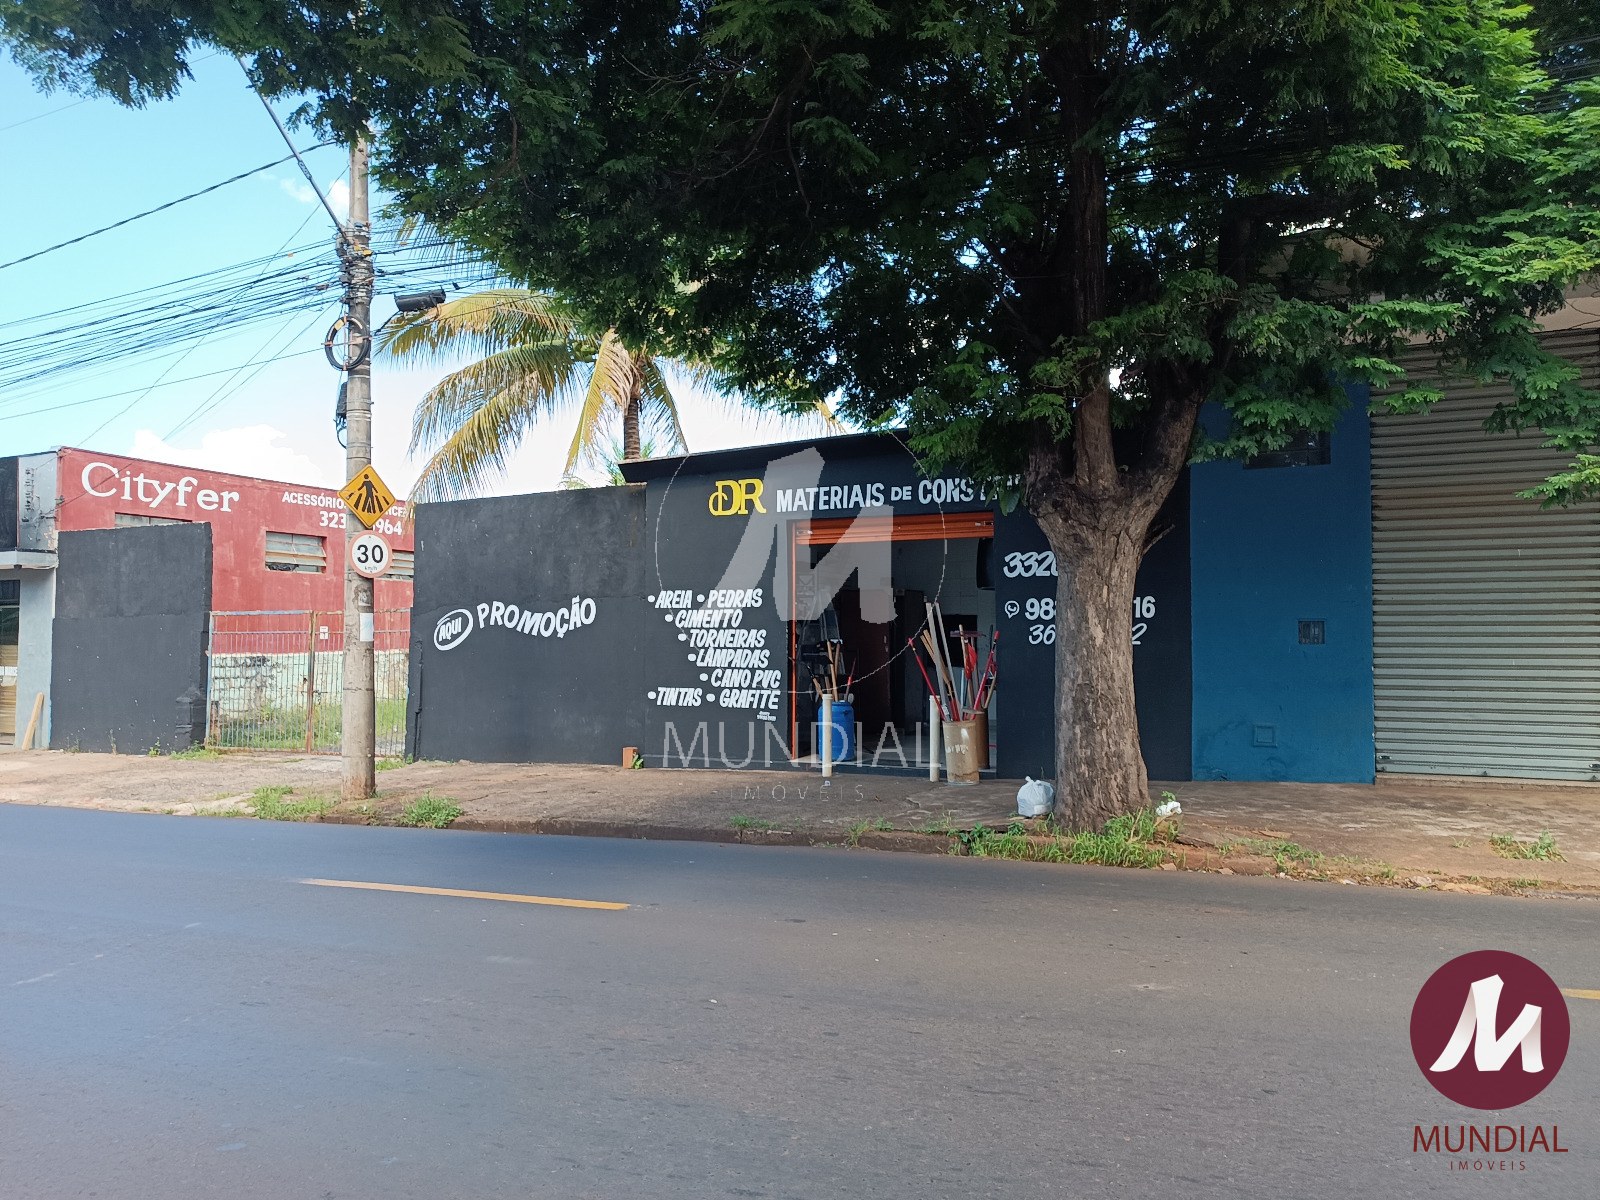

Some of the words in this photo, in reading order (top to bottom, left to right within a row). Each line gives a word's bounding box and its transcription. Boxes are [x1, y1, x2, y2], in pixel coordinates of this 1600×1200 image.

[81, 462, 240, 512] Cityfer
[282, 491, 346, 509] ACESSÓRIO
[776, 482, 885, 513] MATERIAIS
[891, 485, 913, 501] DE
[356, 544, 384, 564] 30
[655, 590, 692, 608] AREIA
[707, 588, 763, 608] PEDRAS
[438, 616, 462, 642] AQUI
[476, 595, 597, 638] PROMOÇÃO
[675, 608, 743, 628] CIMENTO
[689, 628, 767, 648] TORNEIRAS
[711, 668, 751, 688] CANO
[751, 669, 782, 689] PVC
[656, 687, 703, 706] TINTAS
[719, 688, 781, 709] GRAFITE
